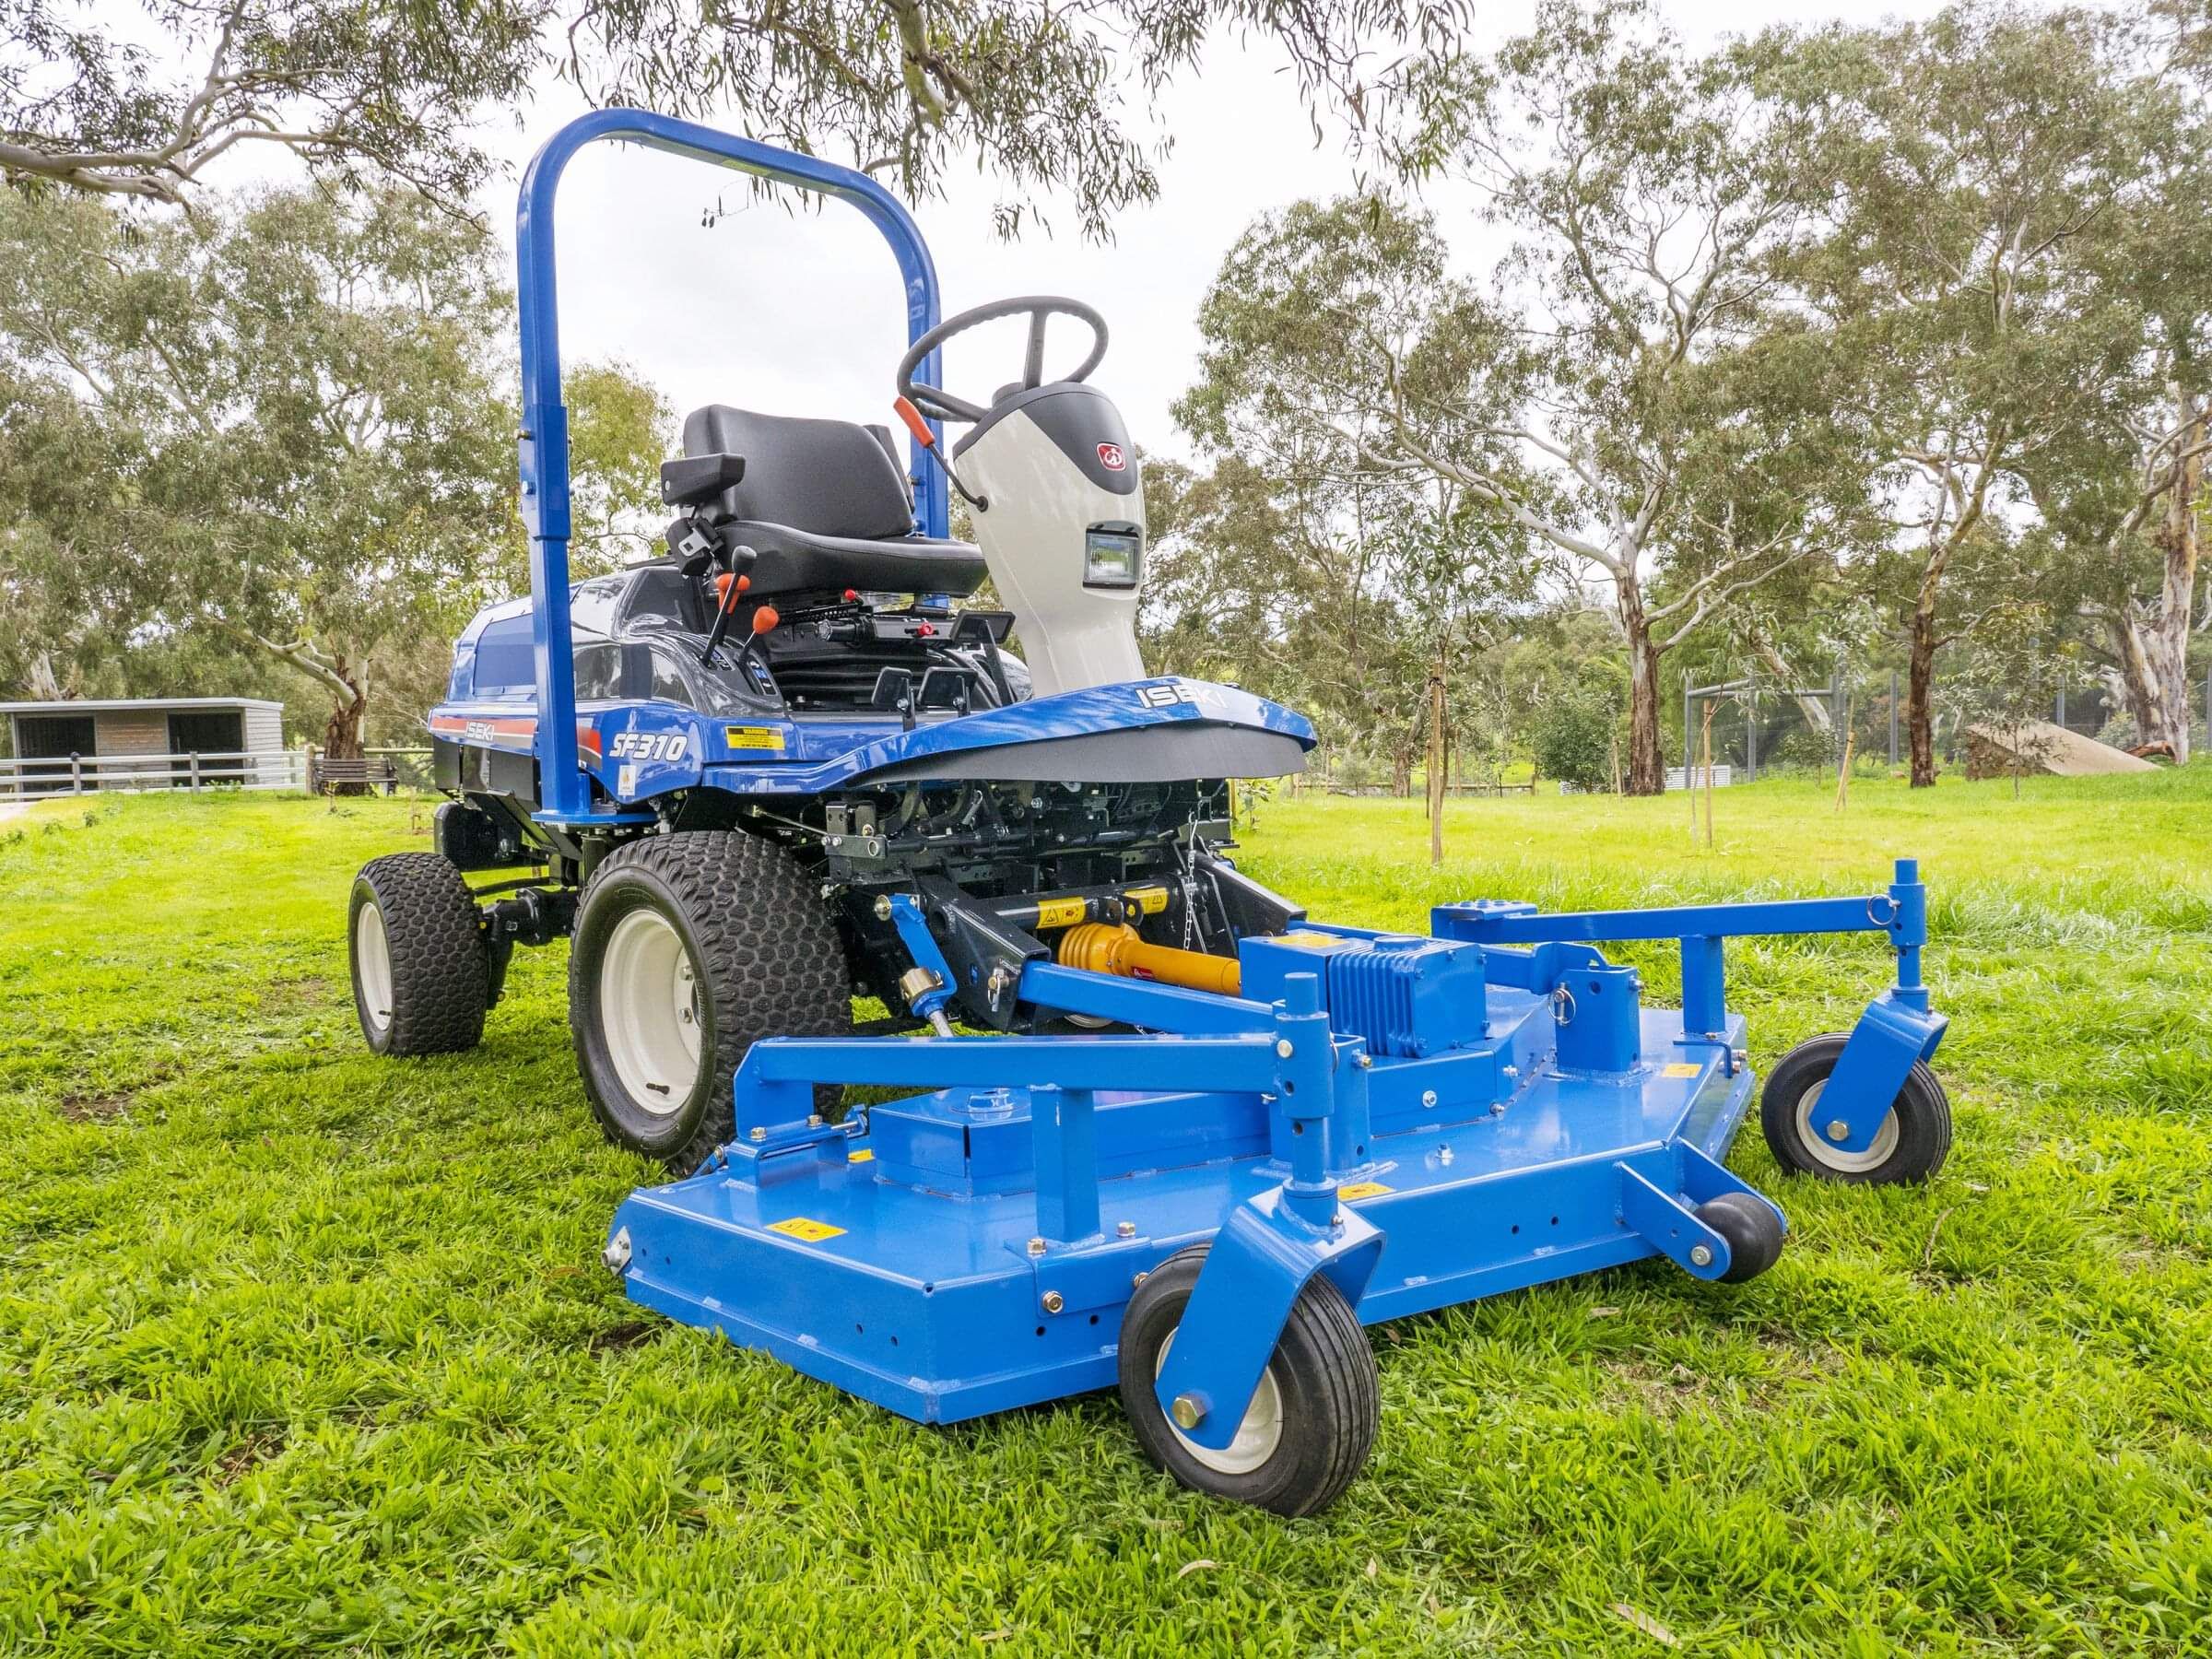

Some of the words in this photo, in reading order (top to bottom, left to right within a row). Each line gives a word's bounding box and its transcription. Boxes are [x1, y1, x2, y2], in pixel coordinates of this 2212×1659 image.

[1135, 684, 1229, 710] ISEKI
[464, 721, 495, 741] ISEKI
[609, 733, 688, 761] SF310
